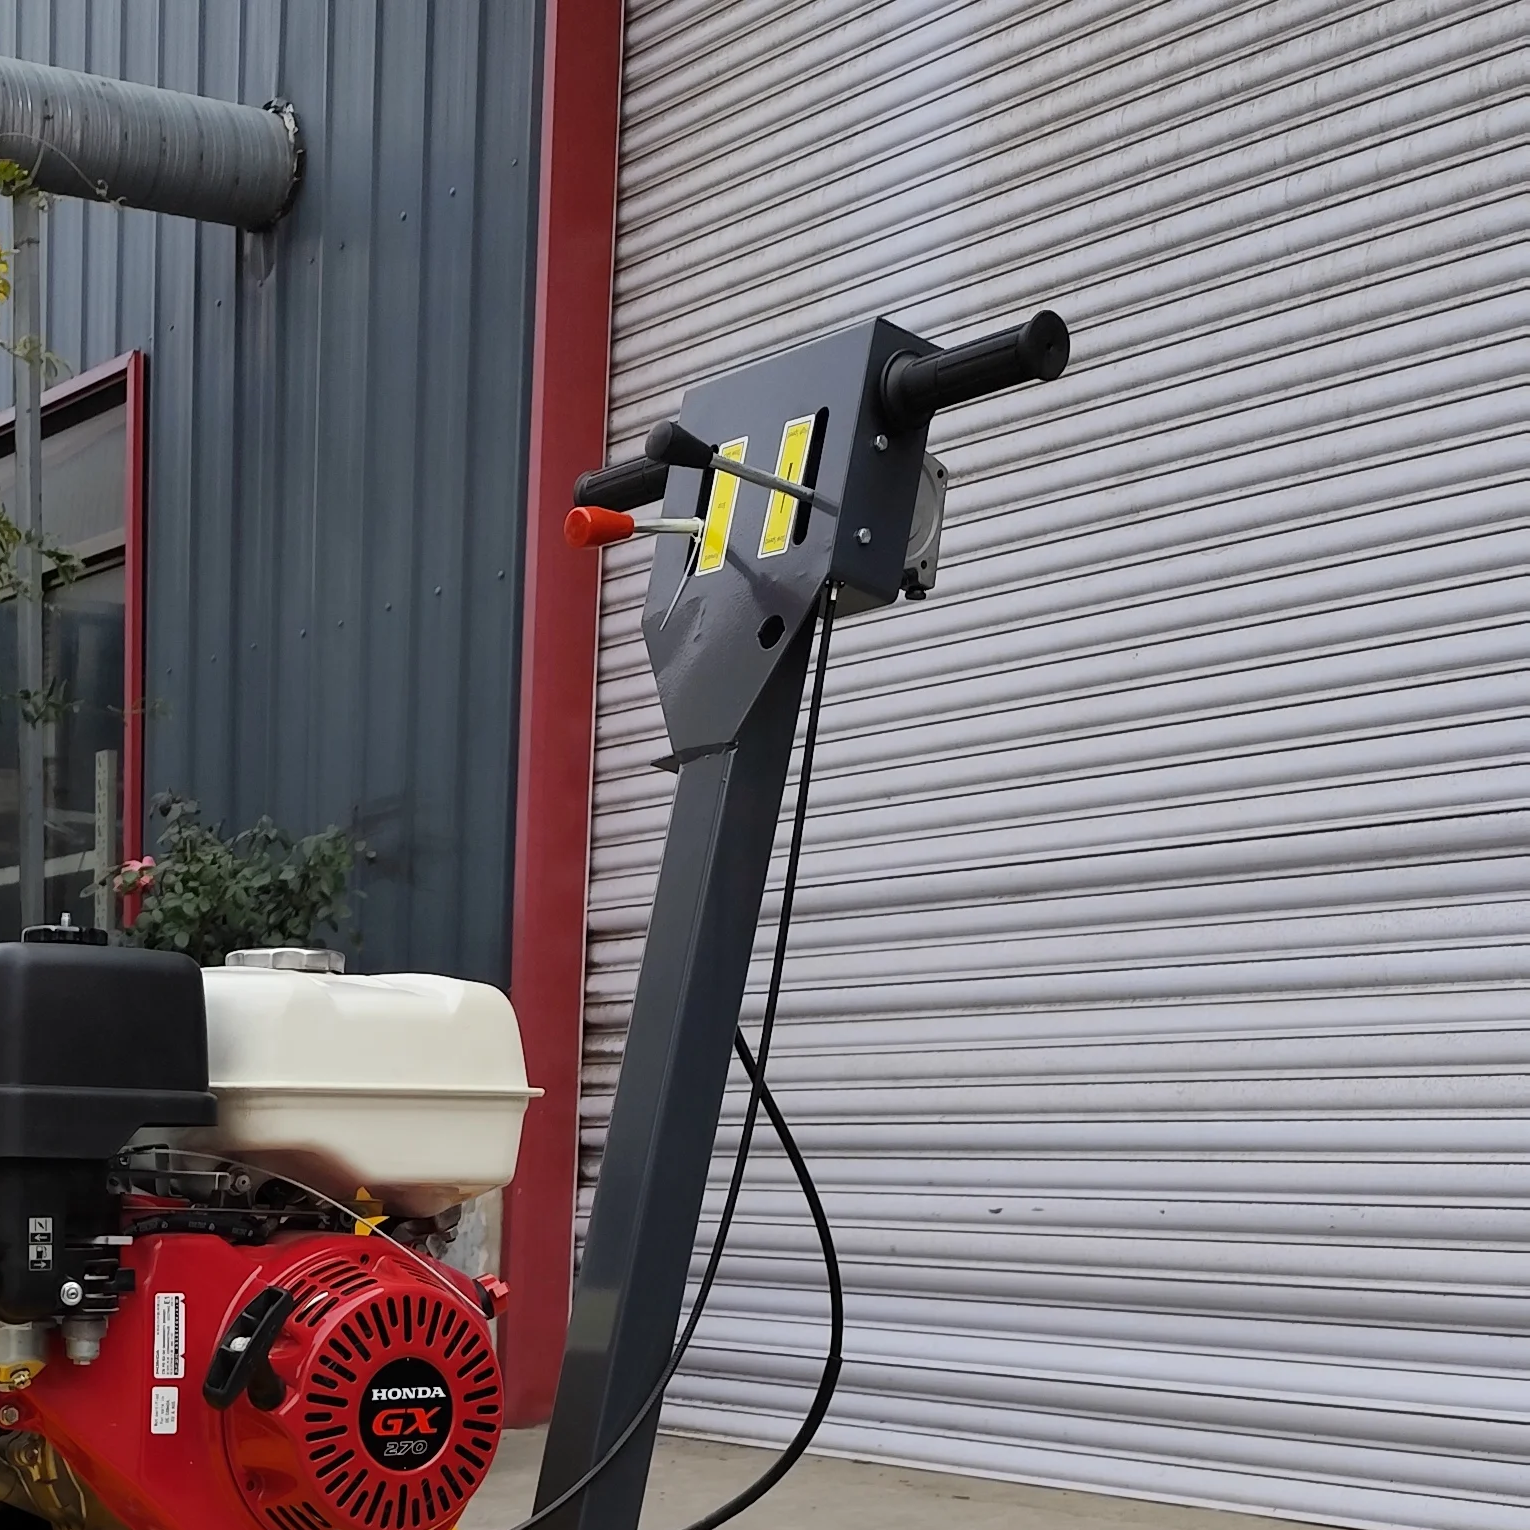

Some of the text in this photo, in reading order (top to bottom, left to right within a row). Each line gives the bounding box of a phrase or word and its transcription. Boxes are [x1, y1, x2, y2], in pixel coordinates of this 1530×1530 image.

[372, 1387, 446, 1401] HONDA
[372, 1407, 442, 1436] GX
[384, 1440, 428, 1457] 270
